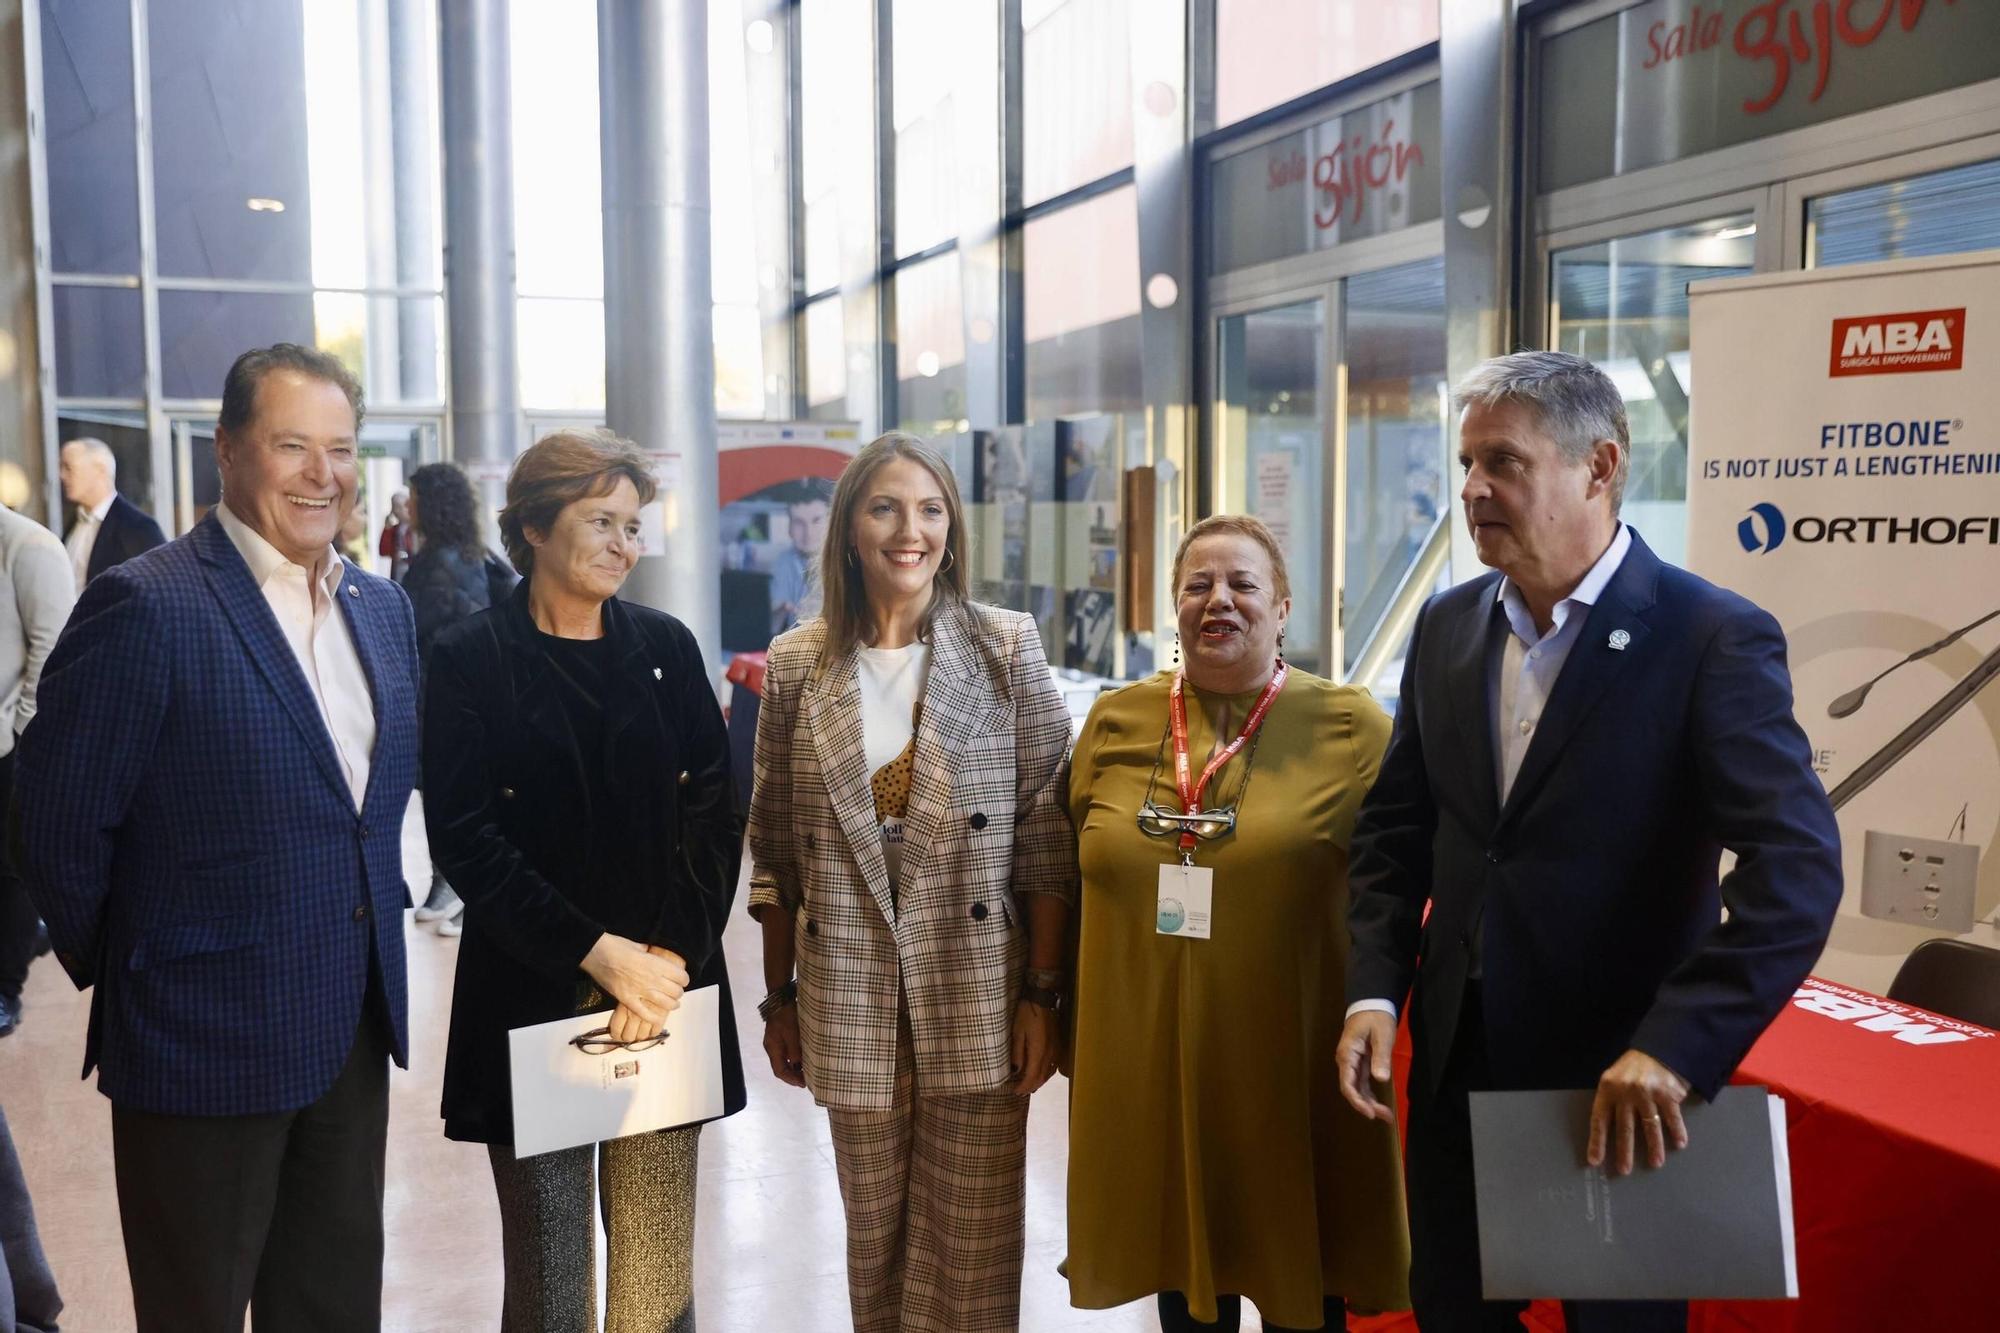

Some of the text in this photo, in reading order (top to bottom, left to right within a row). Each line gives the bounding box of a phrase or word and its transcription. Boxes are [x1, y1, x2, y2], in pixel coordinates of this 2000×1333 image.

[1642, 8, 1724, 70] Sala
[1313, 119, 1424, 229] gijón
[1841, 319, 1953, 358] MBA
[1703, 453, 2000, 479] IS NOT JUST A LENGTHENI
[1792, 517, 2000, 545] ORTHOFI
